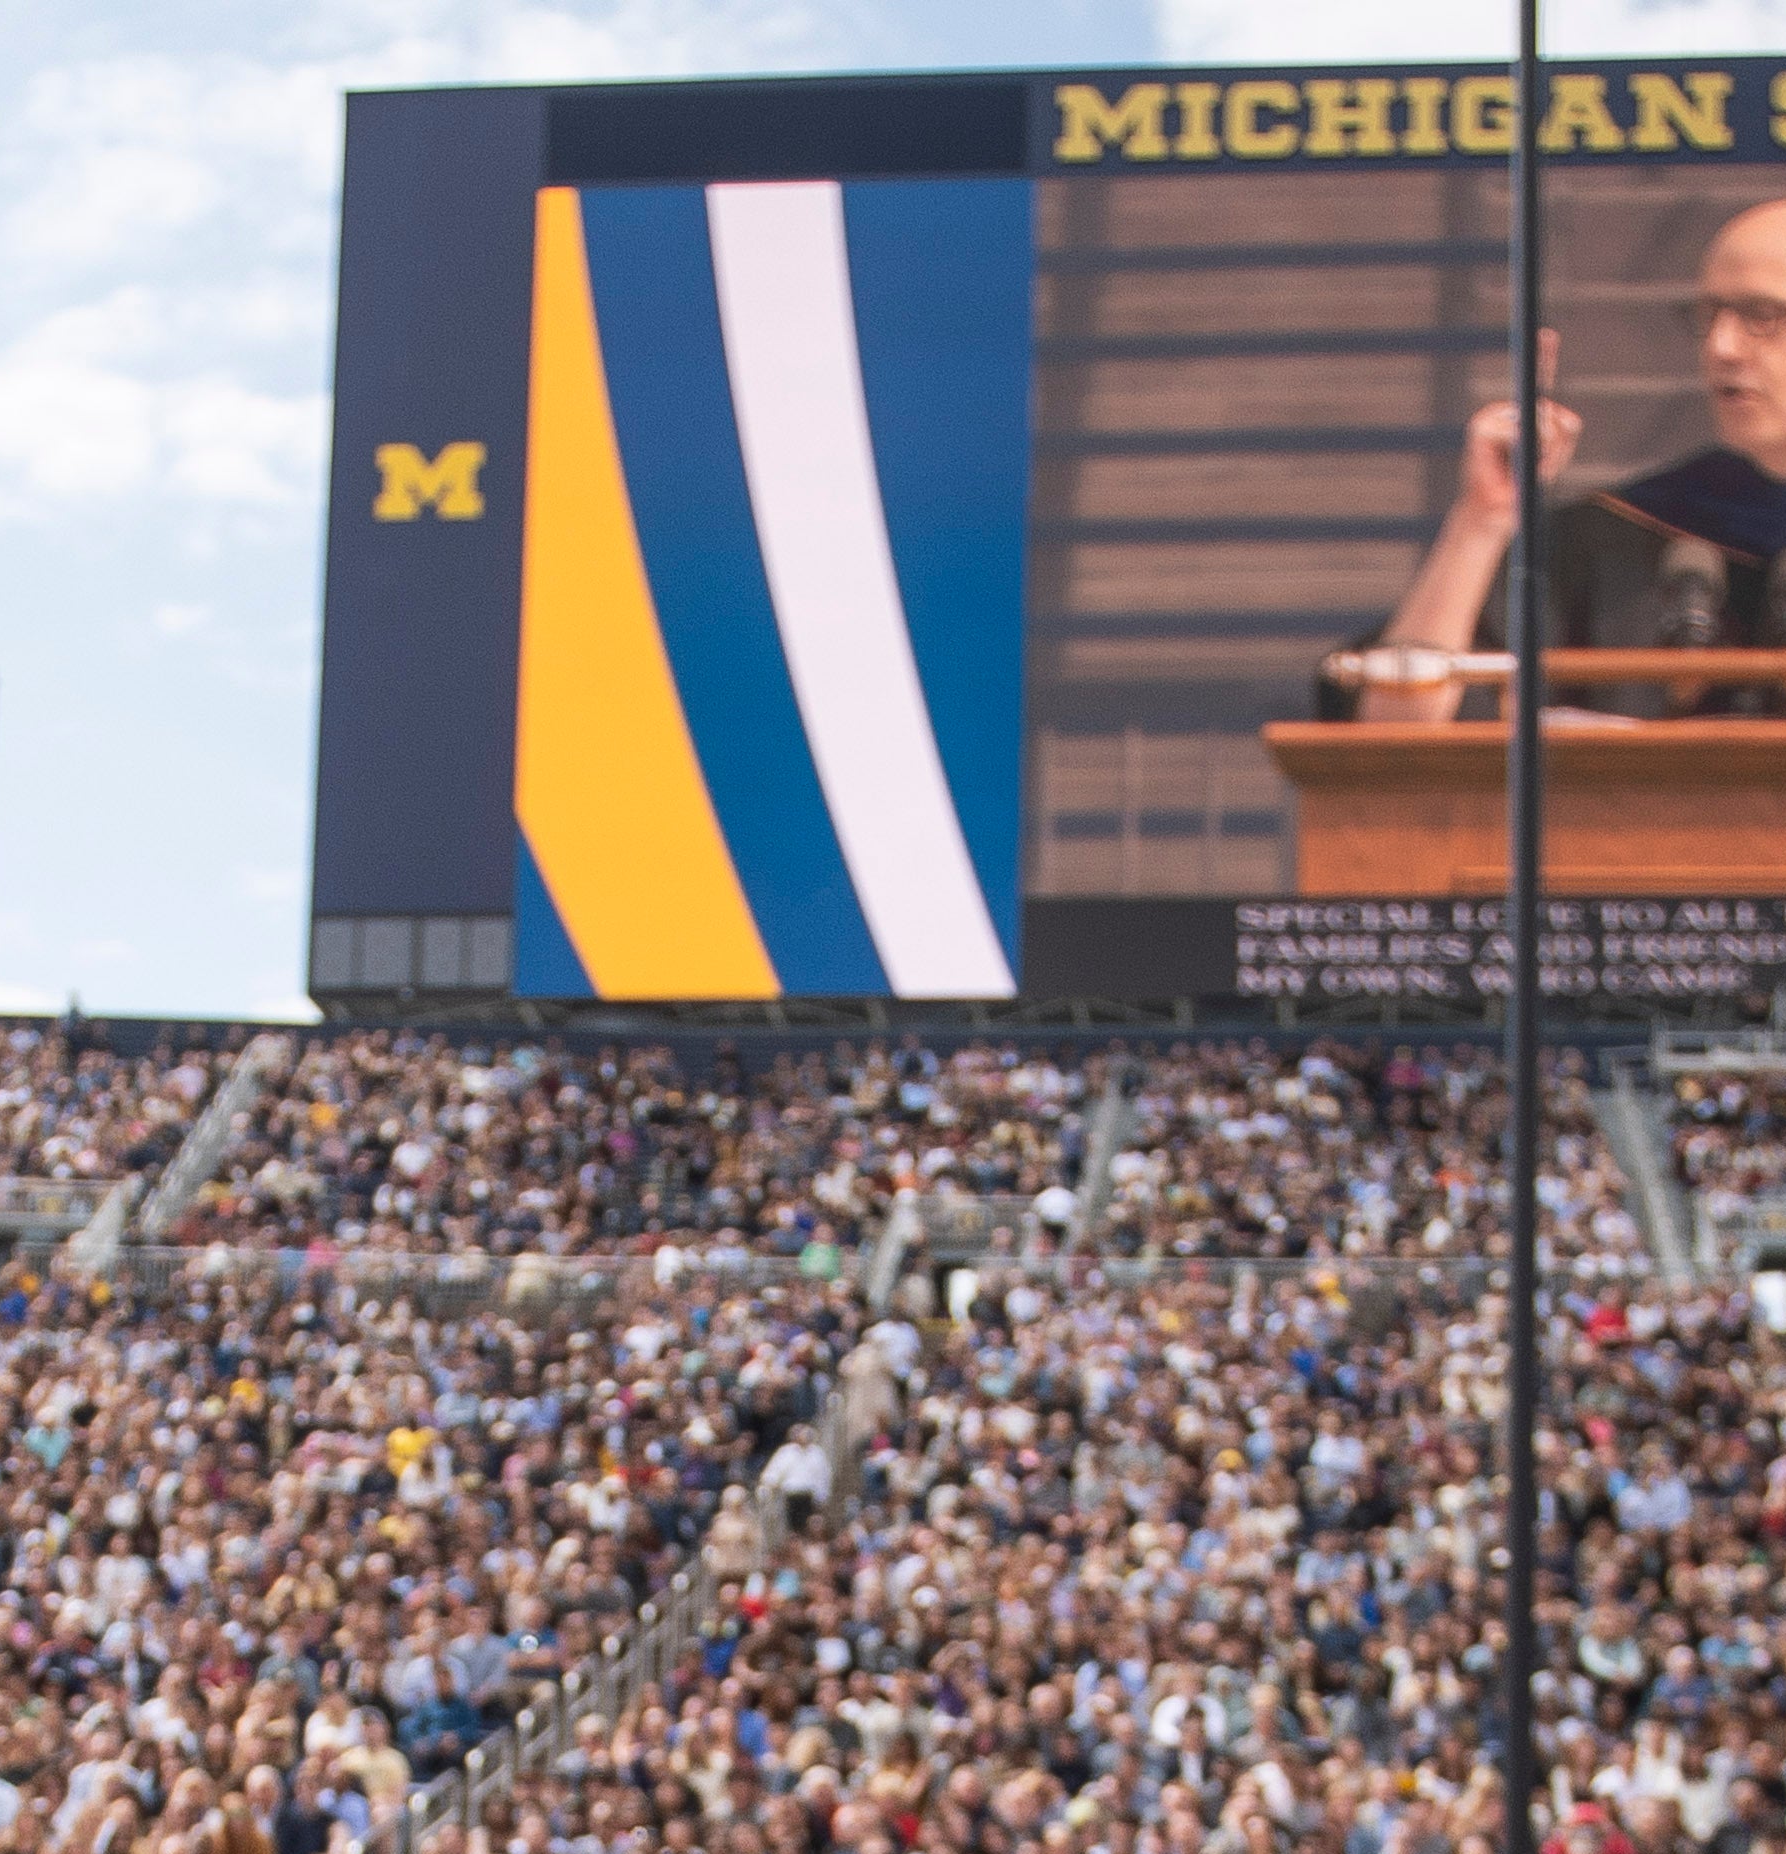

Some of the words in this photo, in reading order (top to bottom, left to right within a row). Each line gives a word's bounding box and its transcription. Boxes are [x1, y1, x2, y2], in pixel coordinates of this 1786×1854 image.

[1054, 72, 1736, 163] MICHIGAN
[372, 440, 487, 523] M
[1451, 902, 1584, 931] LOE
[1591, 902, 1666, 931] TO
[1670, 902, 1771, 931] ALL
[1235, 932, 1473, 963] FAMILIES
[1235, 964, 1309, 996] MY
